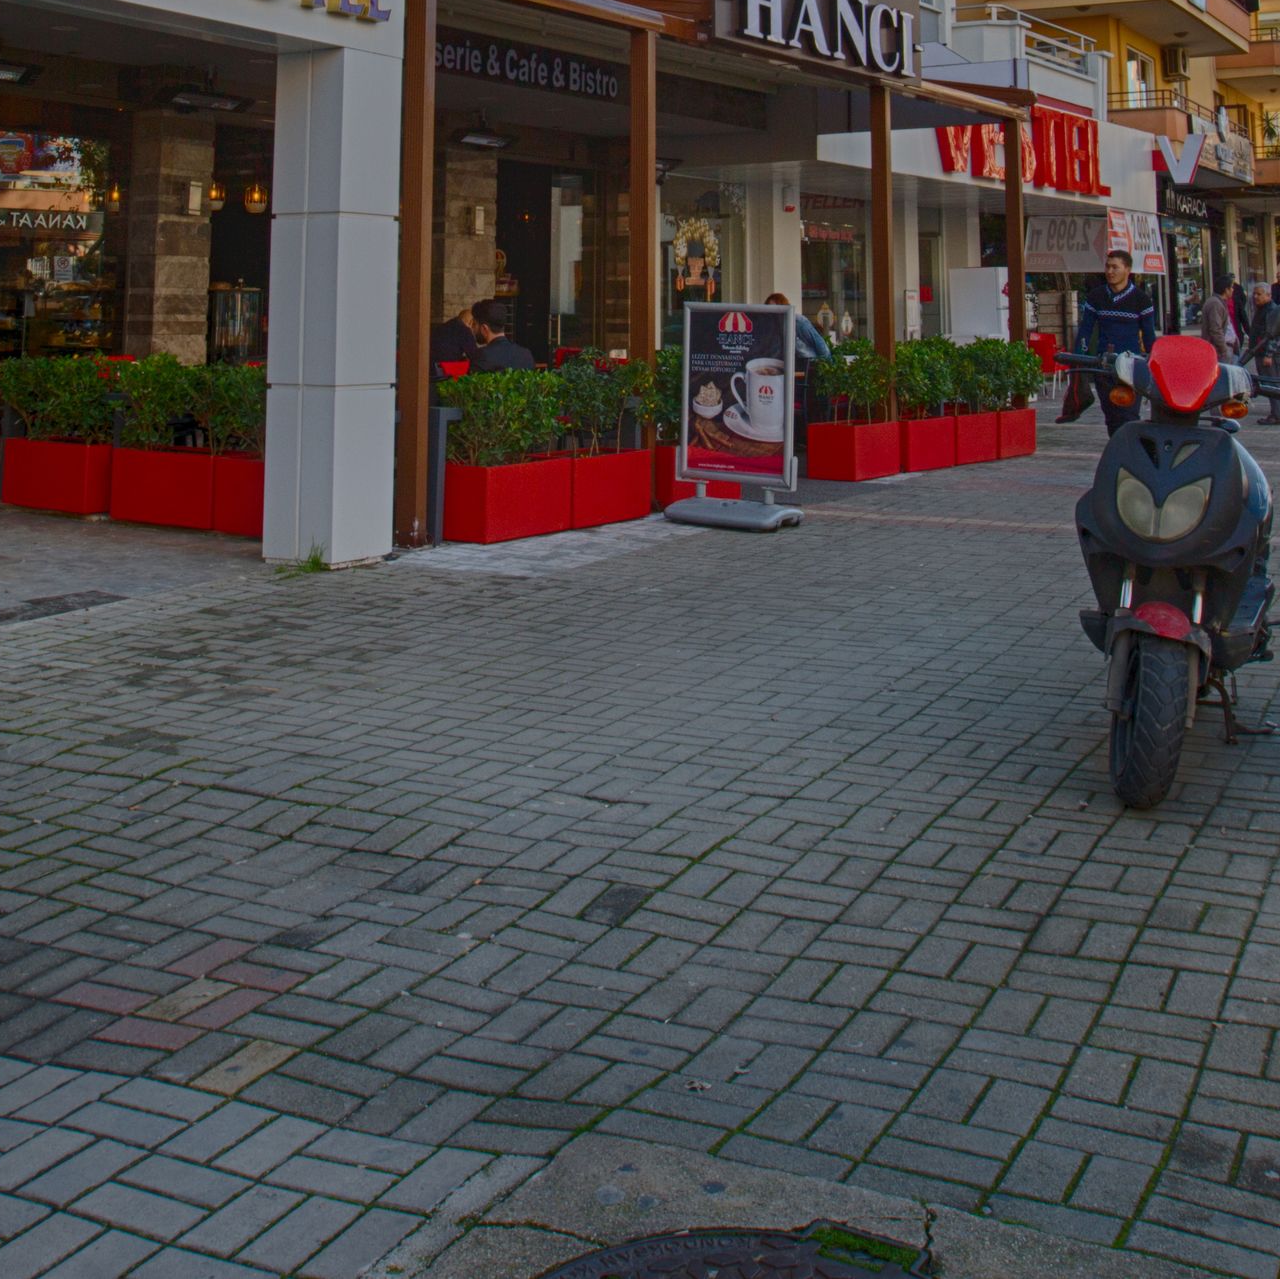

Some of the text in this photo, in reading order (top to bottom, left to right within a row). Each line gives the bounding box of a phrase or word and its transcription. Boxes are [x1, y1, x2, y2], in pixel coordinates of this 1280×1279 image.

[487, 44, 501, 76] &
[505, 49, 548, 85] Cafe
[552, 57, 565, 88] &
[569, 61, 618, 97] Bistro
[1176, 193, 1208, 218] KARACA
